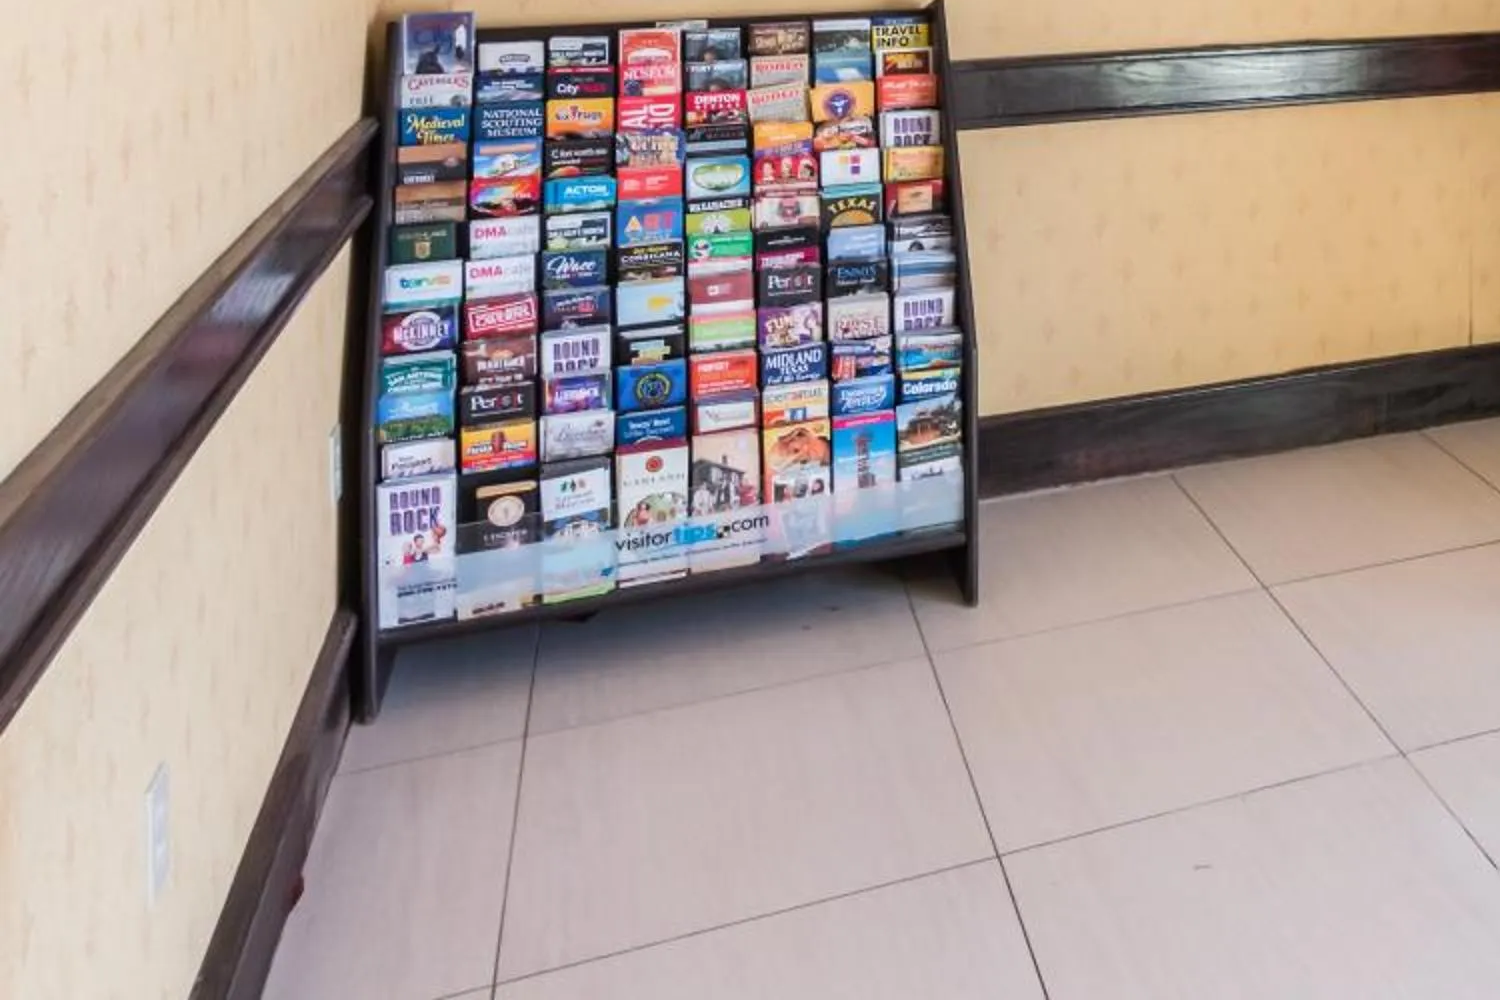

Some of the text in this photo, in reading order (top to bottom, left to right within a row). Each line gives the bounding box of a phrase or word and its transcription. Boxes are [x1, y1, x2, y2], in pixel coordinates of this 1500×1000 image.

[875, 25, 922, 37] TRAVEL
[876, 36, 910, 48] INFO
[482, 107, 543, 120] NATIONAL
[405, 112, 466, 135] Medieval
[481, 118, 543, 129] SCOUTING
[893, 116, 932, 134] ROUND
[486, 127, 538, 138] MUSEUM
[473, 225, 508, 240] DMA
[469, 264, 504, 279] DMA
[903, 297, 944, 317] ROUND
[552, 337, 601, 360] ROUND
[766, 348, 823, 370] MIDLAND
[902, 379, 958, 396] Colorado
[388, 485, 443, 511] ROUND
[388, 505, 443, 537] ROCK
